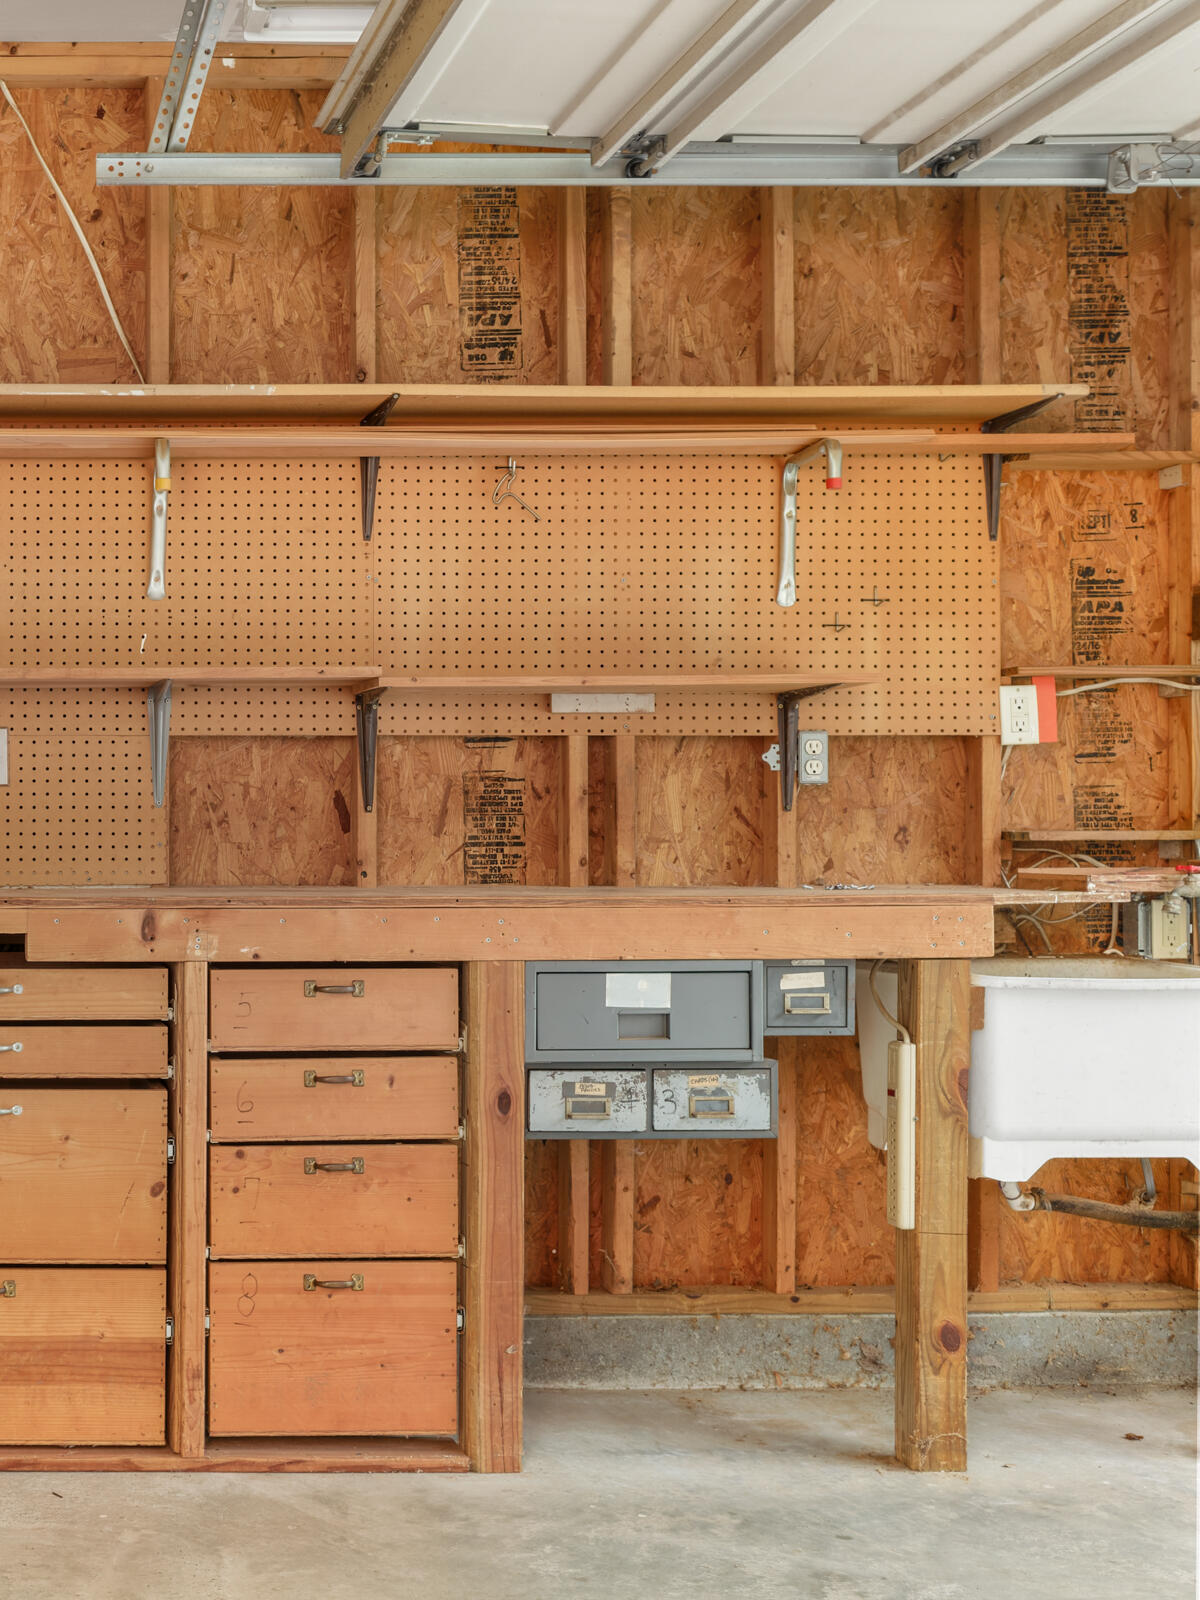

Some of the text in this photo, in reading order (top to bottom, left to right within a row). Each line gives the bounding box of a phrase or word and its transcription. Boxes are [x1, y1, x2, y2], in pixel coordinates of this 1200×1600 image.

[236, 1081, 255, 1114] 6
[662, 1089, 677, 1115] 3
[236, 1272, 259, 1317] 8
